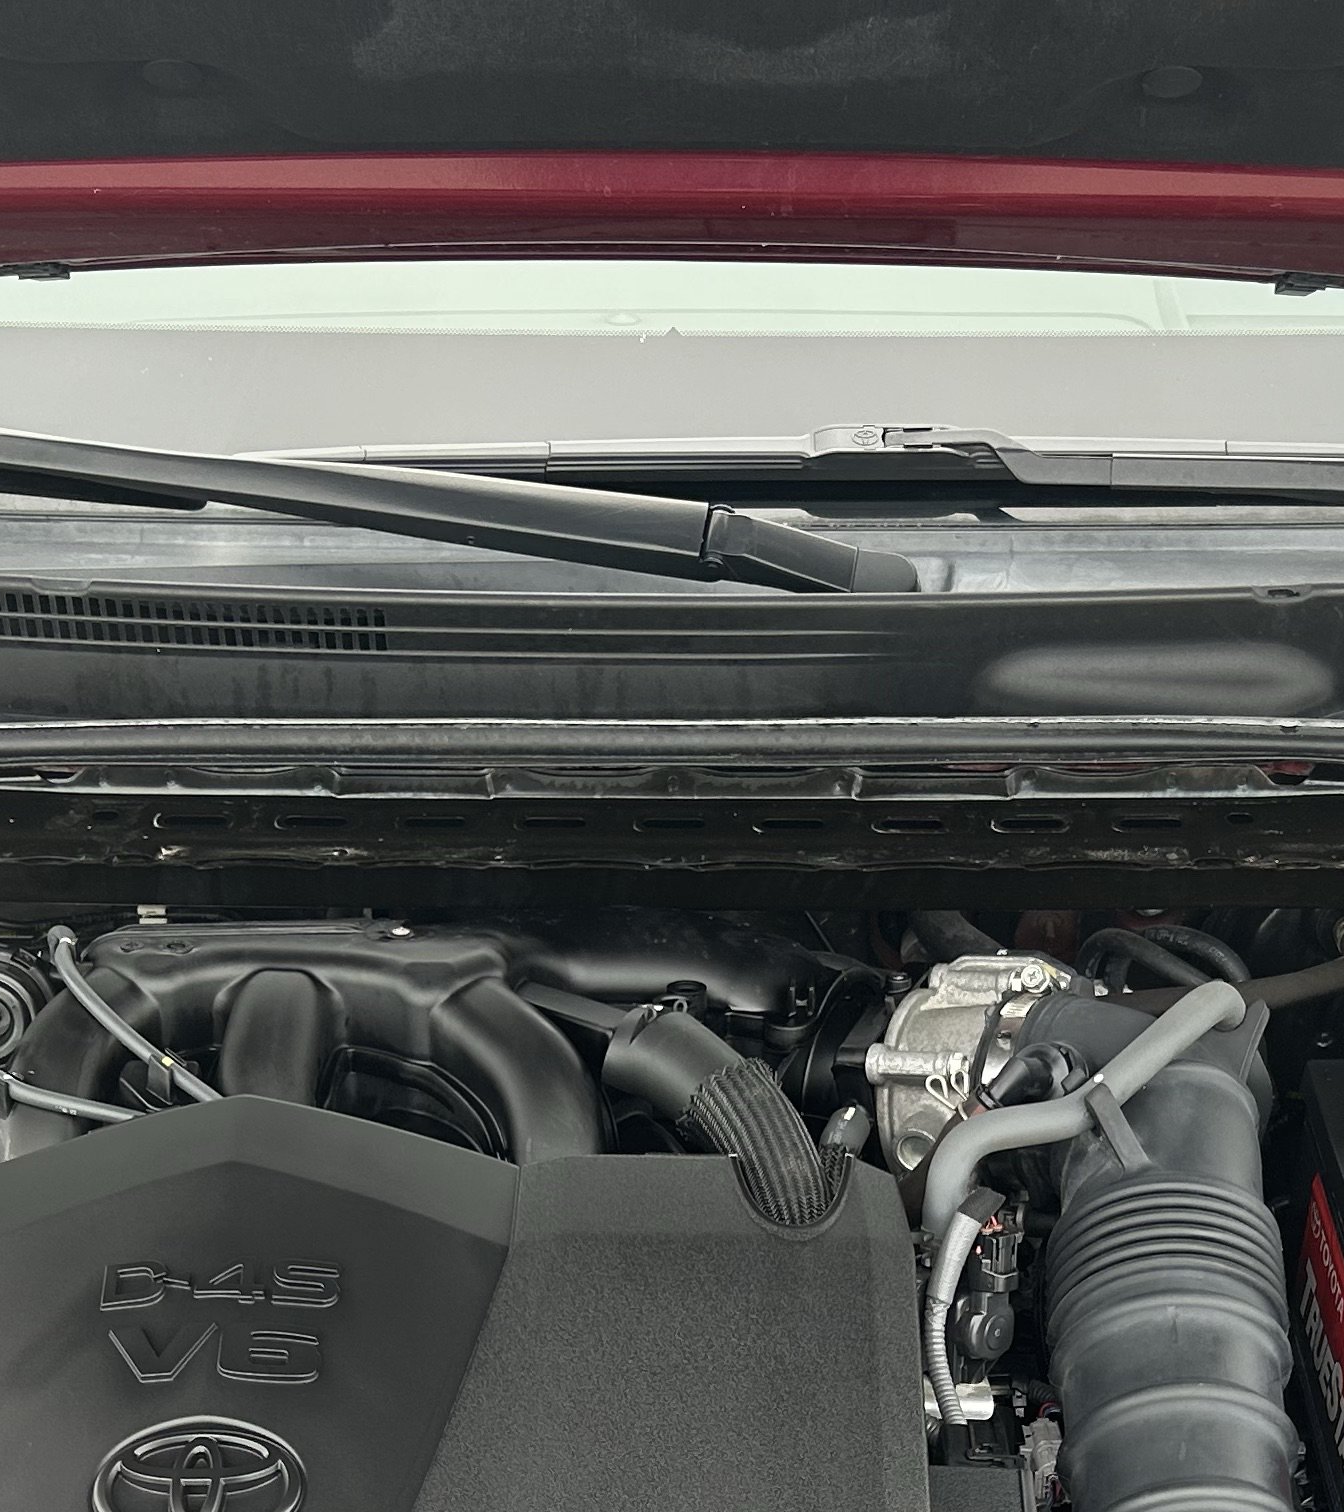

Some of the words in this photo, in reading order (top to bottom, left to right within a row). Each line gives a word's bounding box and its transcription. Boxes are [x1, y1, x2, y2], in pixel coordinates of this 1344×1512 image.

[99, 1254, 342, 1312] D-4S
[1318, 1230, 1344, 1323] TOYOTA
[107, 1321, 323, 1385] V6
